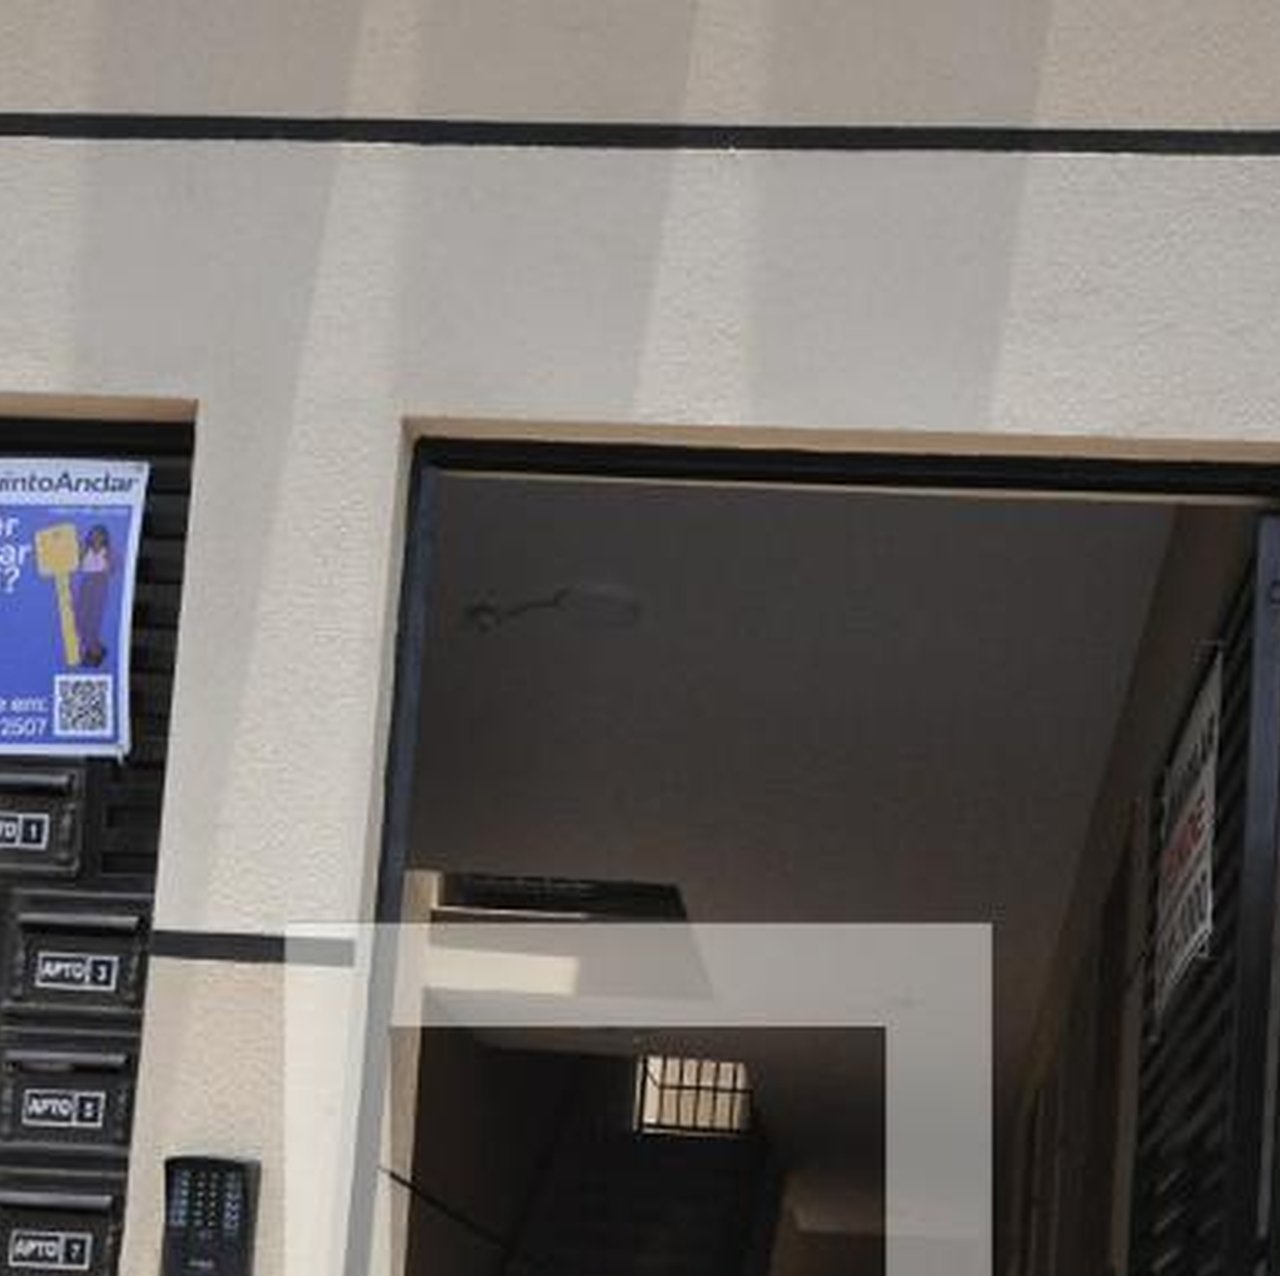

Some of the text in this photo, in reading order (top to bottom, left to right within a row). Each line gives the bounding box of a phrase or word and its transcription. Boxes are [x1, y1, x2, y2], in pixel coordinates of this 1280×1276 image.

[41, 960, 86, 981] APTO
[27, 1096, 72, 1116] APTO
[15, 1239, 58, 1259] APTO
